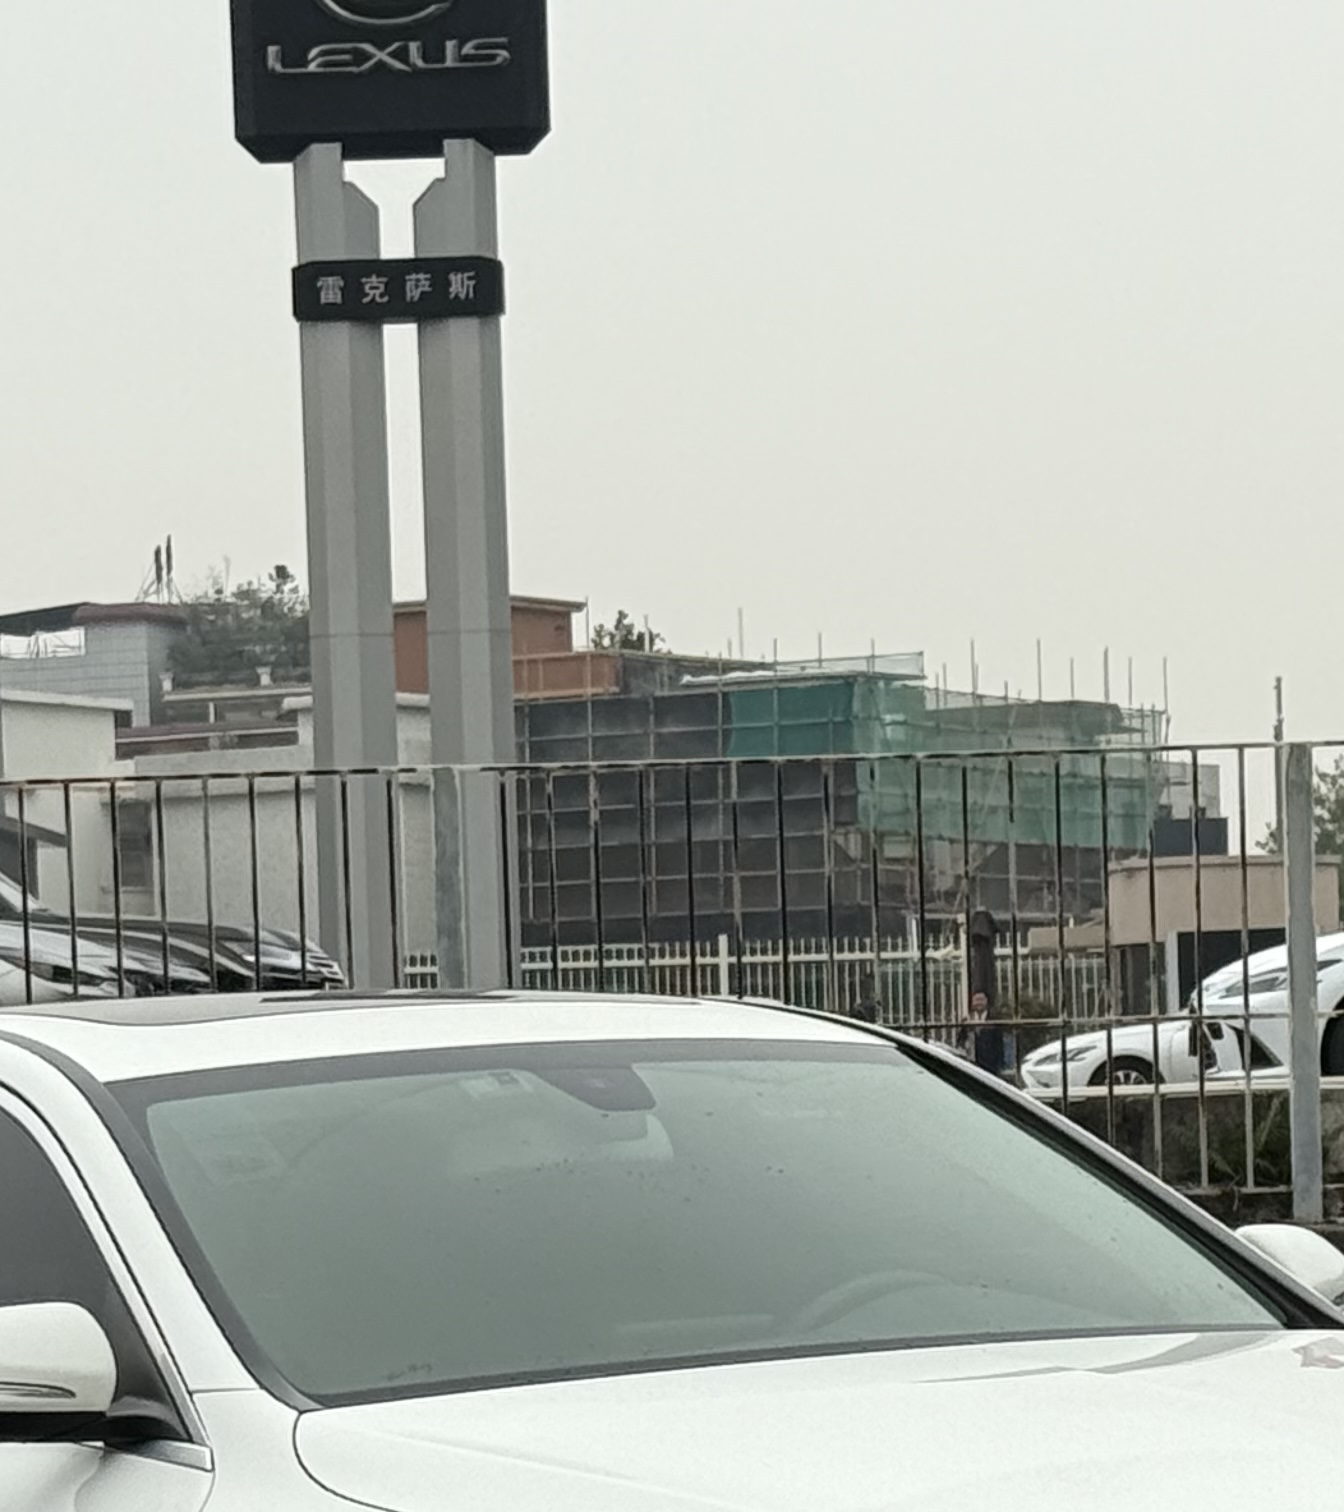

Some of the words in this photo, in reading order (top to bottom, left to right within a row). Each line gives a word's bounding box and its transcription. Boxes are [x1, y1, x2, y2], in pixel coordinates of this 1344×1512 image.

[267, 37, 511, 73] LEXUS
[316, 271, 477, 305] 雷克萨斯
